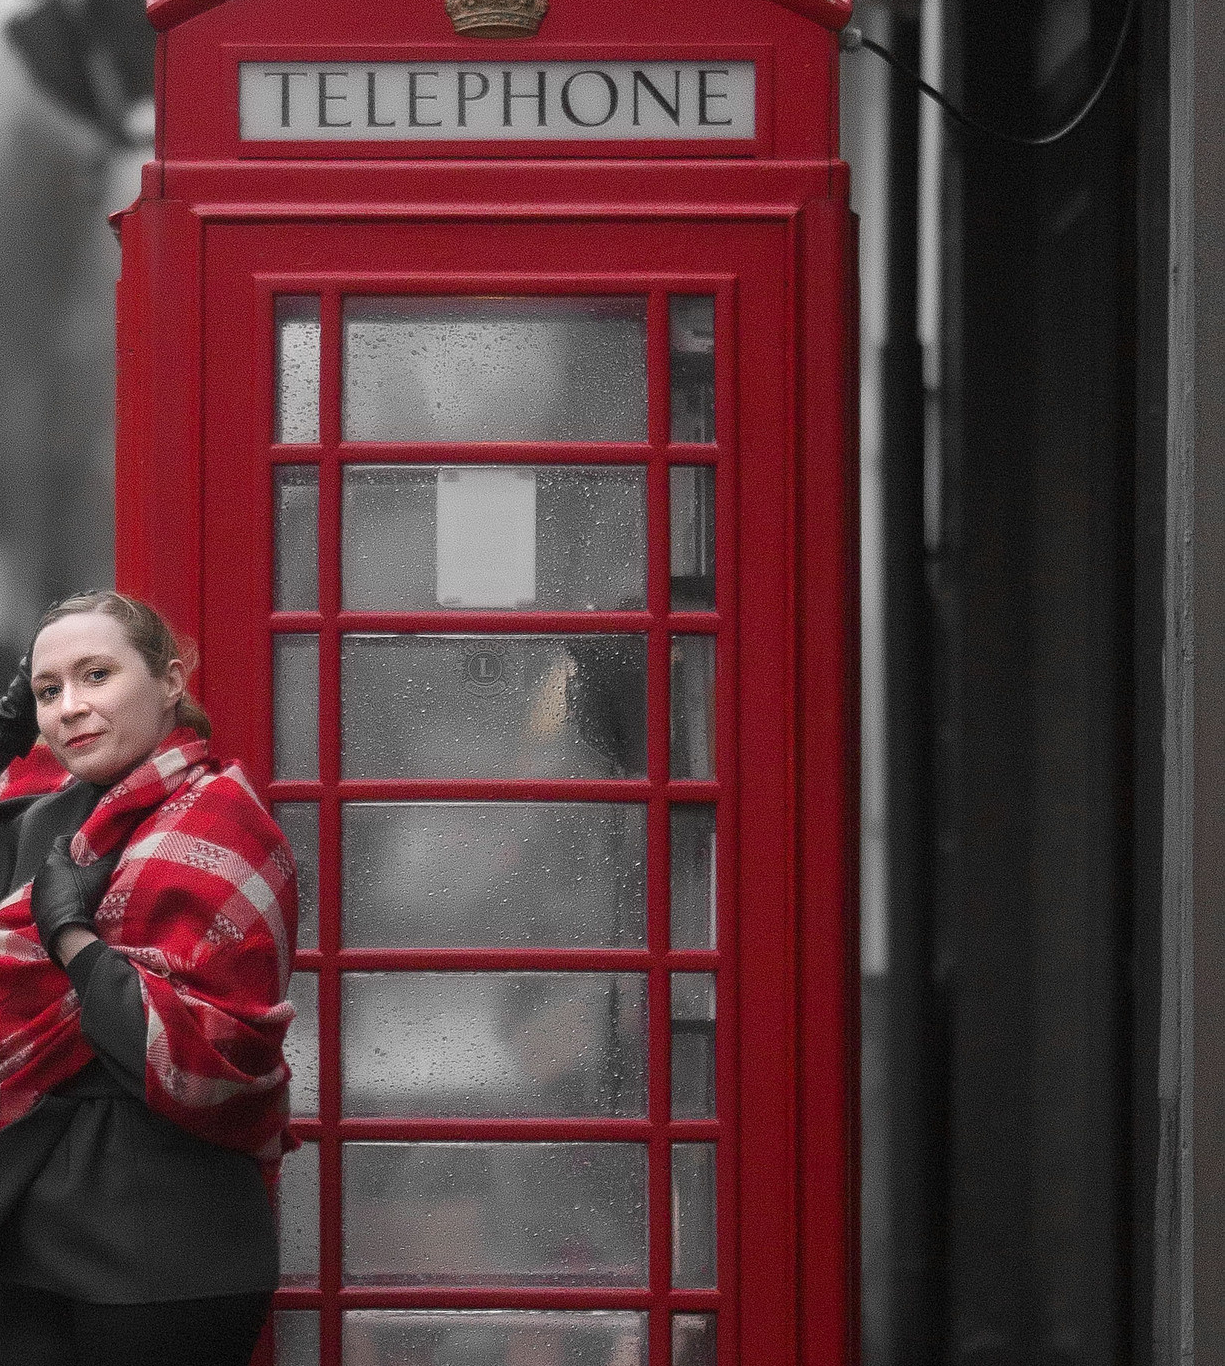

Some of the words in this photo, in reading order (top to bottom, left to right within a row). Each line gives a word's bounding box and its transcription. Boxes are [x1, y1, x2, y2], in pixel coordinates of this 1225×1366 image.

[263, 69, 734, 128] TELEPHONE
[466, 641, 504, 654] LIONS
[478, 657, 494, 677] L
